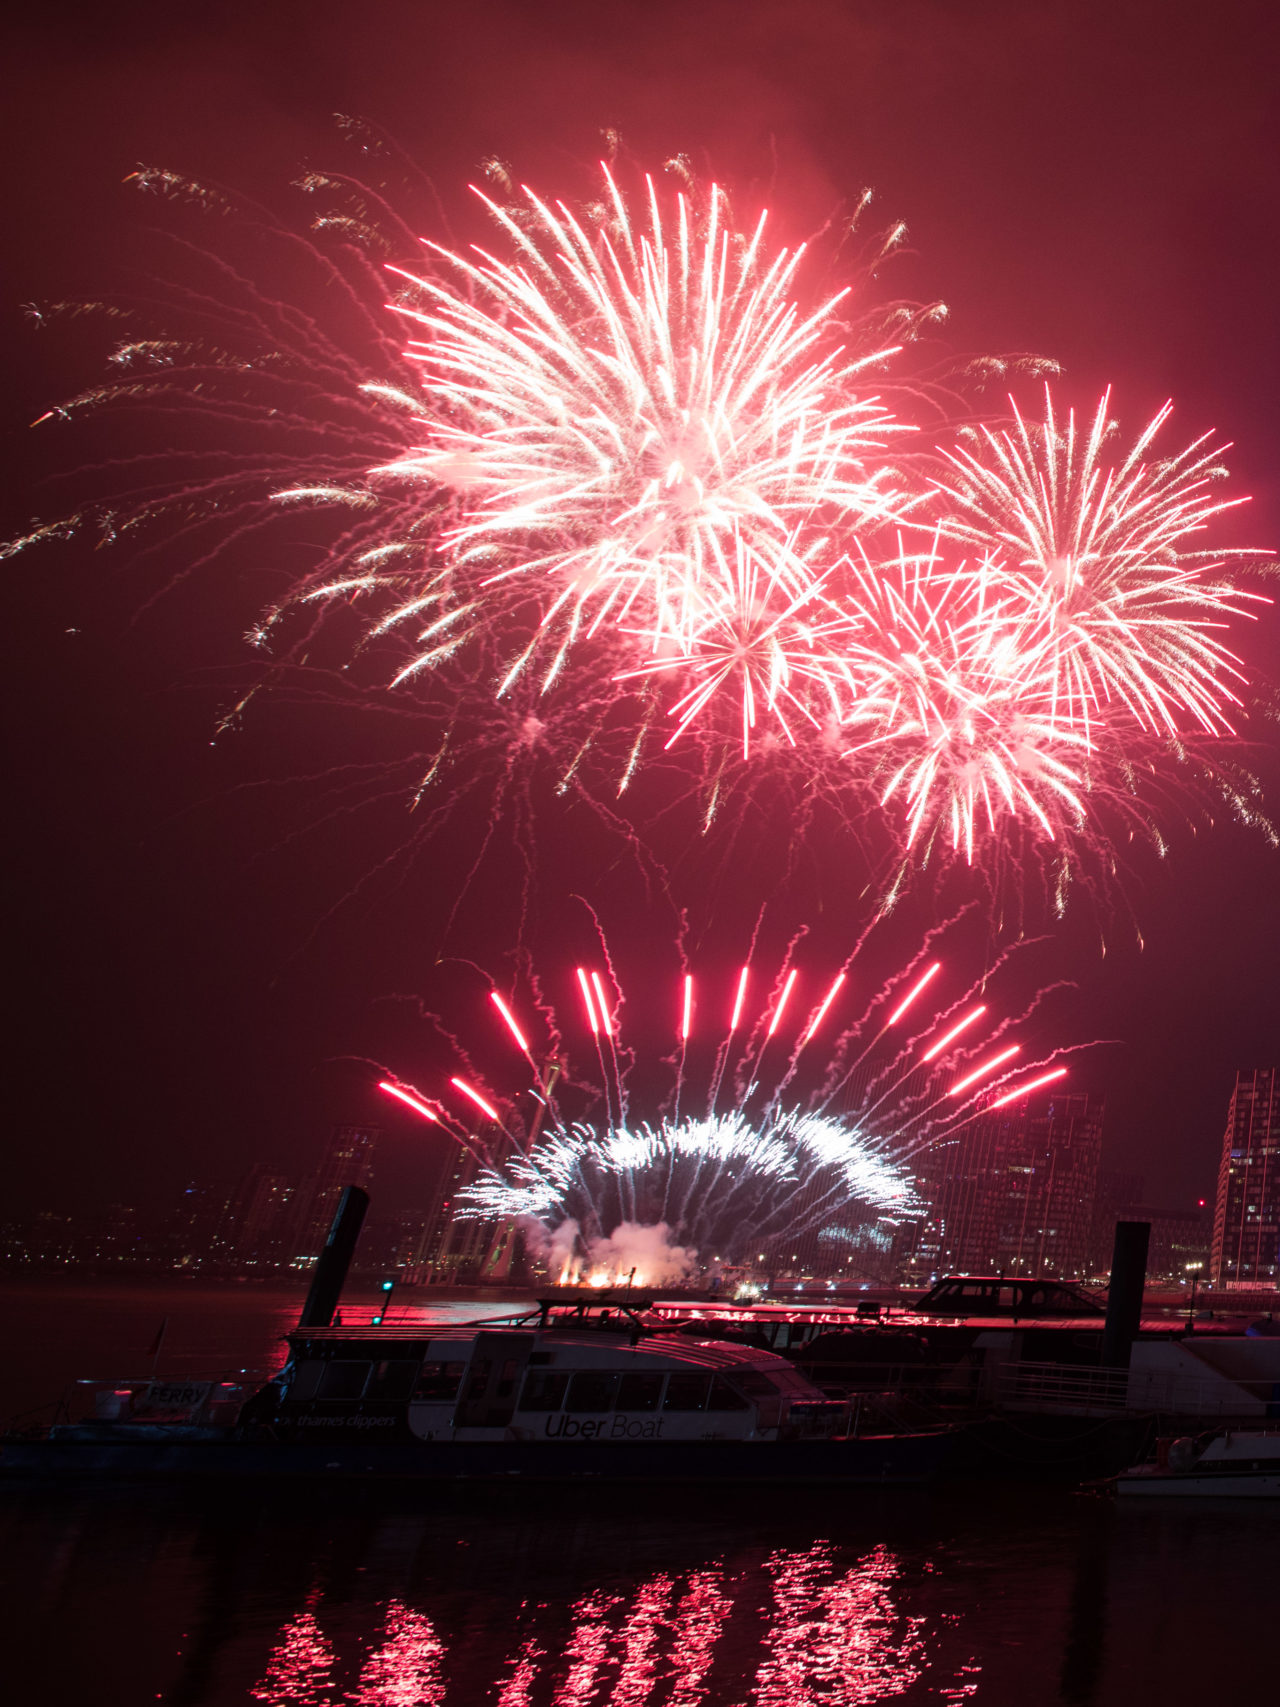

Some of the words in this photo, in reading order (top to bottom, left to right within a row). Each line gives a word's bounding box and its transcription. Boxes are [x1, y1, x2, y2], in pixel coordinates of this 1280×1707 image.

[150, 1386, 204, 1403] FERRY
[346, 1414, 397, 1430] clippers
[545, 1414, 606, 1438] Uber
[610, 1414, 665, 1438] Boat
